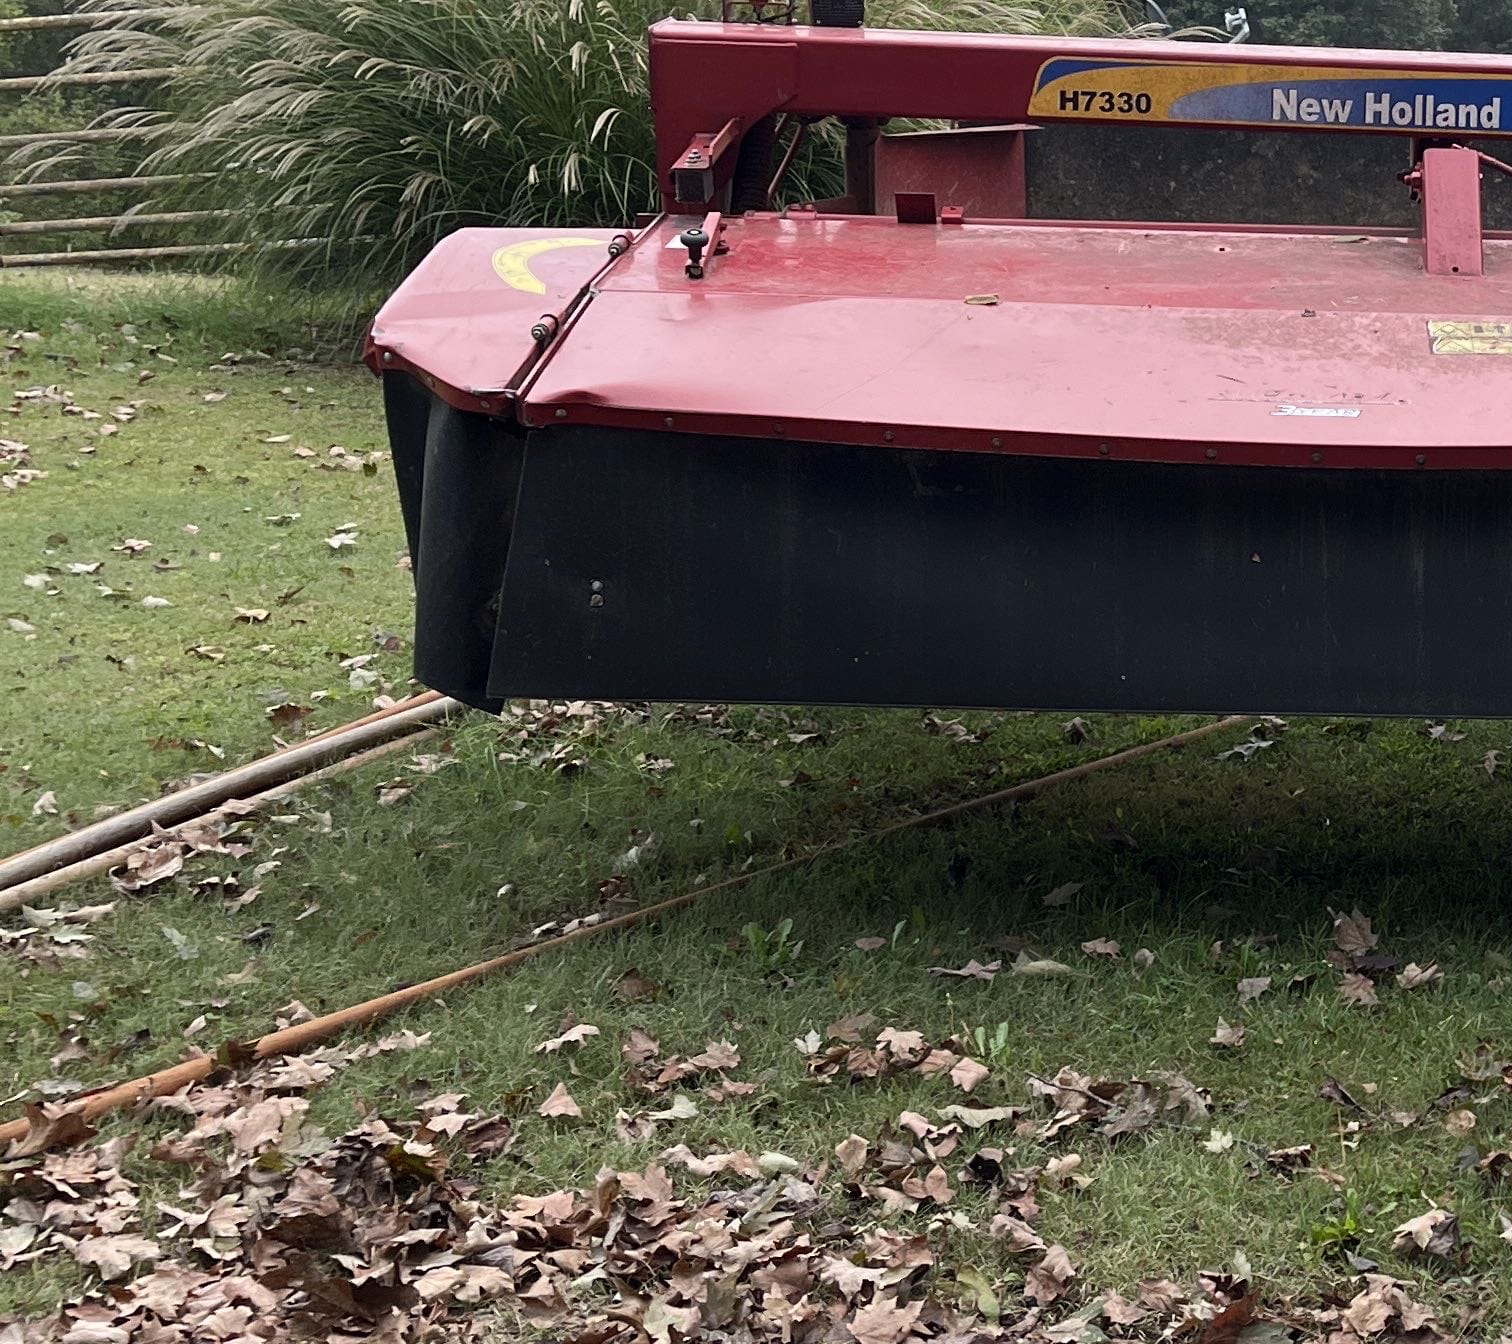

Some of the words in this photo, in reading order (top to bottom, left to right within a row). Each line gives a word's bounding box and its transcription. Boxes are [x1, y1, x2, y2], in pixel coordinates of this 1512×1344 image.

[1059, 90, 1152, 114] H7330
[1271, 88, 1354, 123] New
[1364, 92, 1501, 129] Holland
